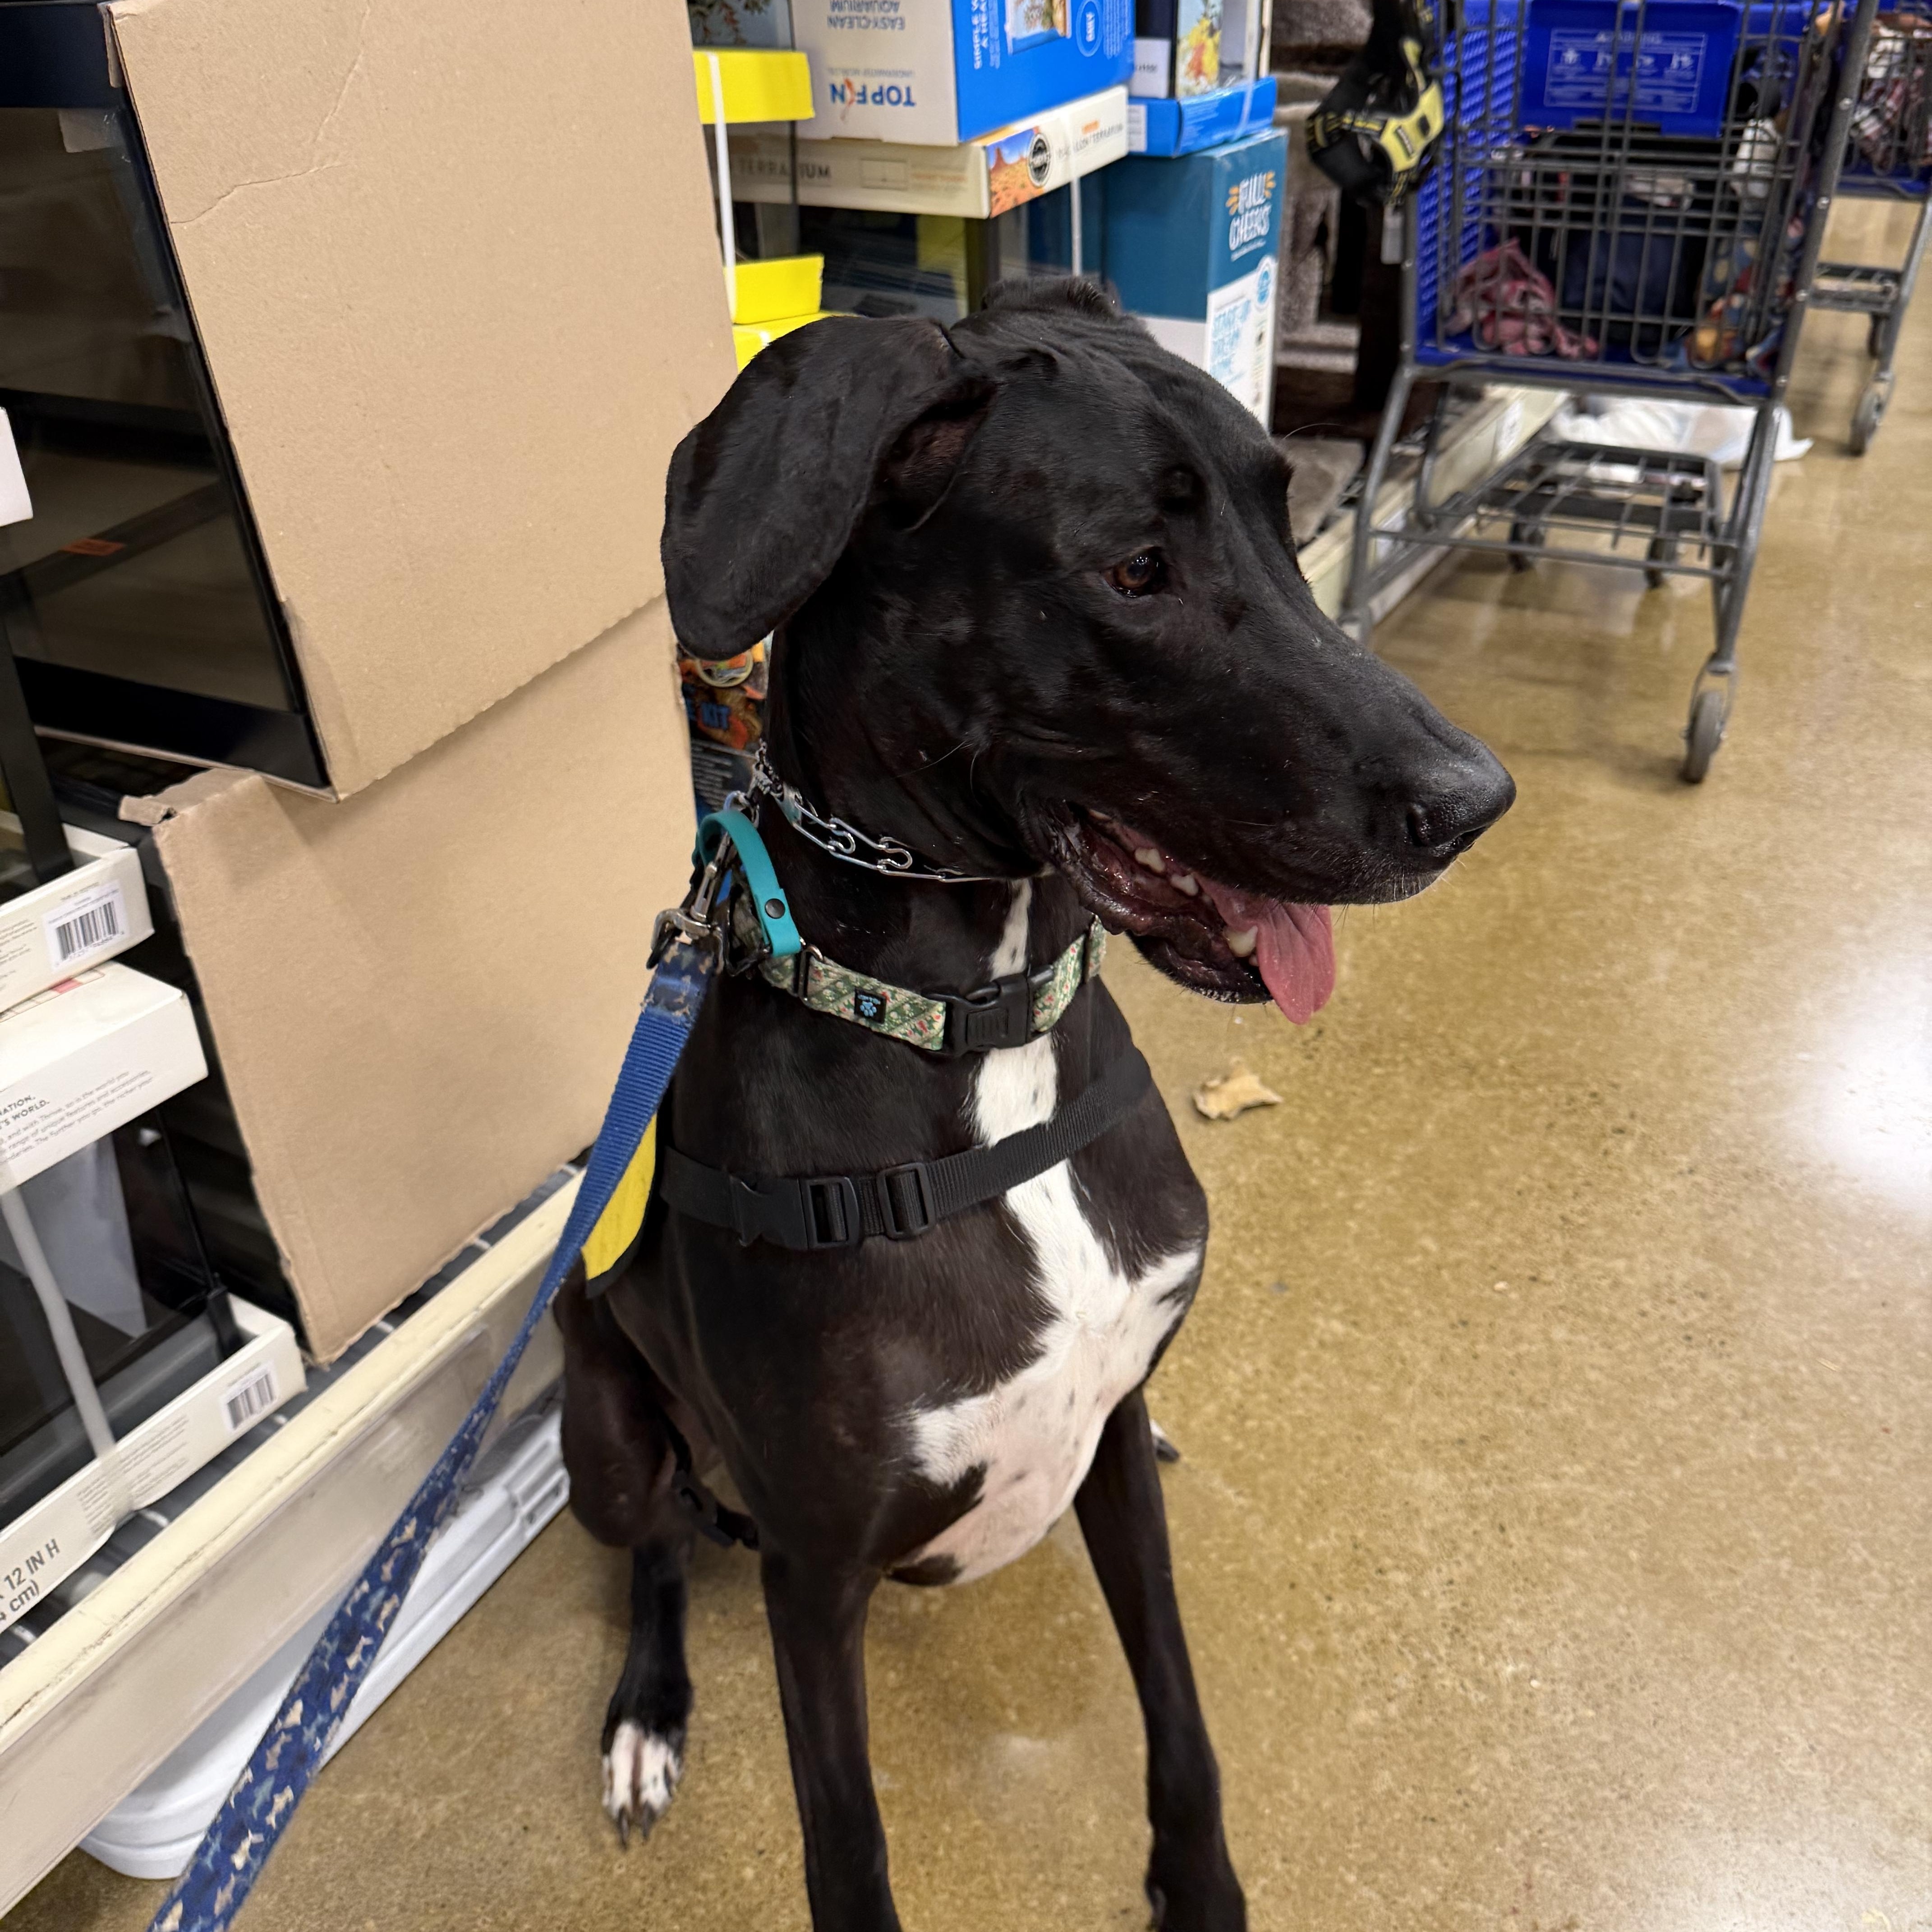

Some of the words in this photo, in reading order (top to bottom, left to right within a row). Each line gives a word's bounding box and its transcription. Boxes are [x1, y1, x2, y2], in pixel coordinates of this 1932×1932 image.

[830, 0, 900, 13] AQUARIUM
[0, 1095, 36, 1115] ATION.
[12, 1099, 50, 1120] WORLD.
[4, 1567, 26, 1591] 12
[25, 1550, 46, 1575] IN
[45, 1538, 60, 1559] H
[9, 1579, 40, 1612] cm)
